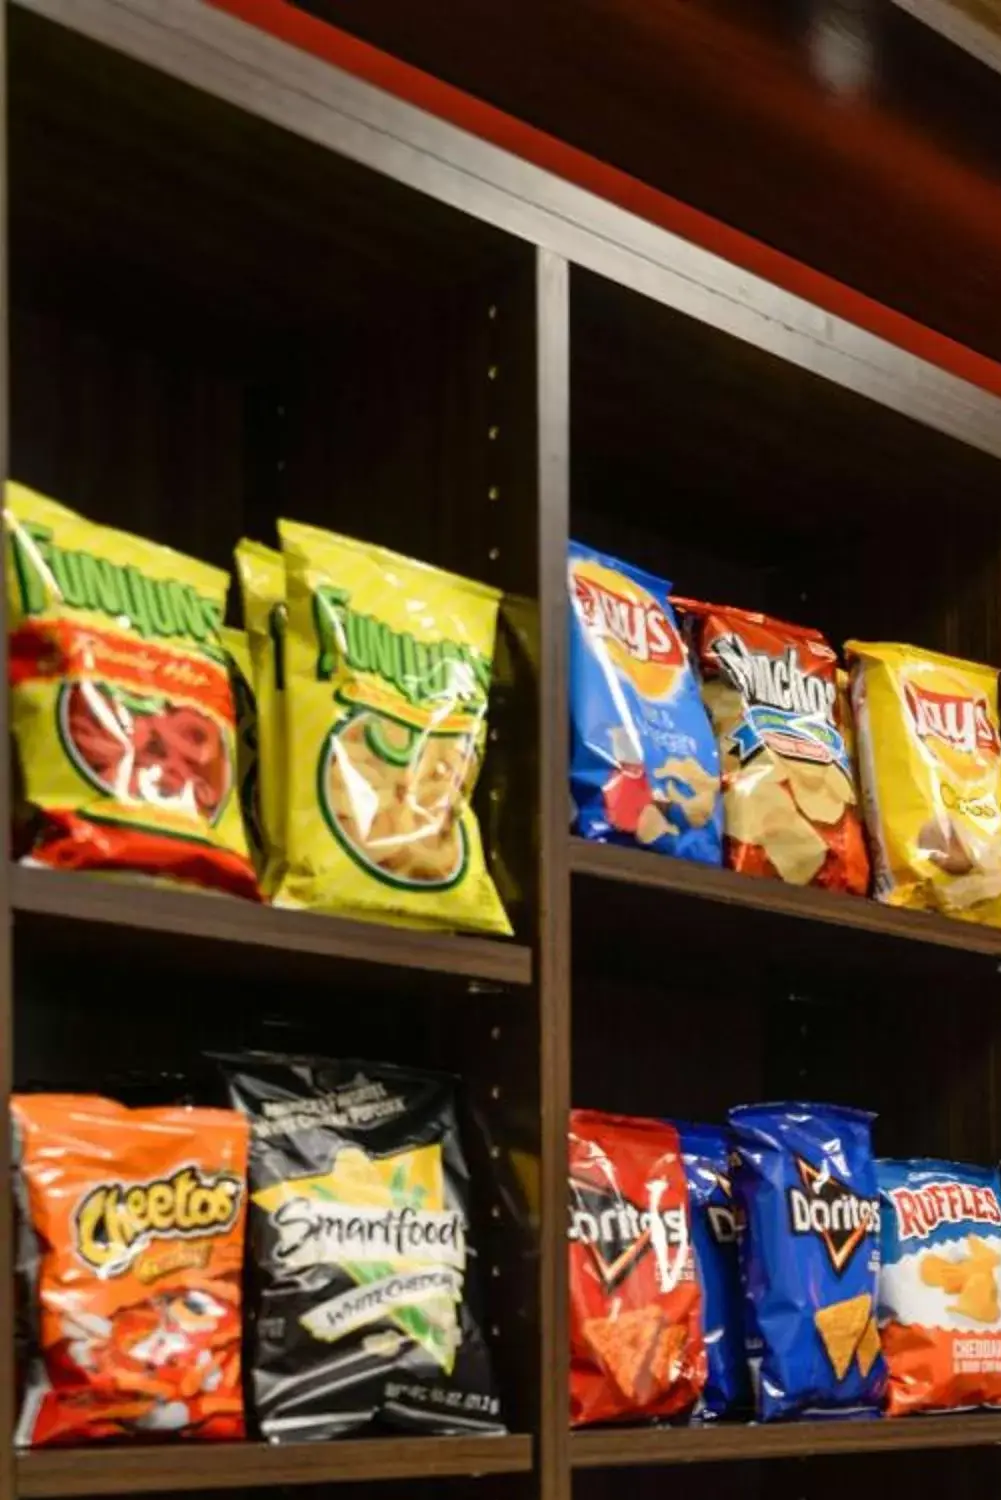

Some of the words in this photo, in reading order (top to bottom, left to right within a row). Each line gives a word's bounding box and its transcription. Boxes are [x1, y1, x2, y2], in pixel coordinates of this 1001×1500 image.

[78, 1166, 242, 1268] Cheetos
[273, 1193, 463, 1260] Smartfood
[793, 1187, 881, 1232] Doritos
